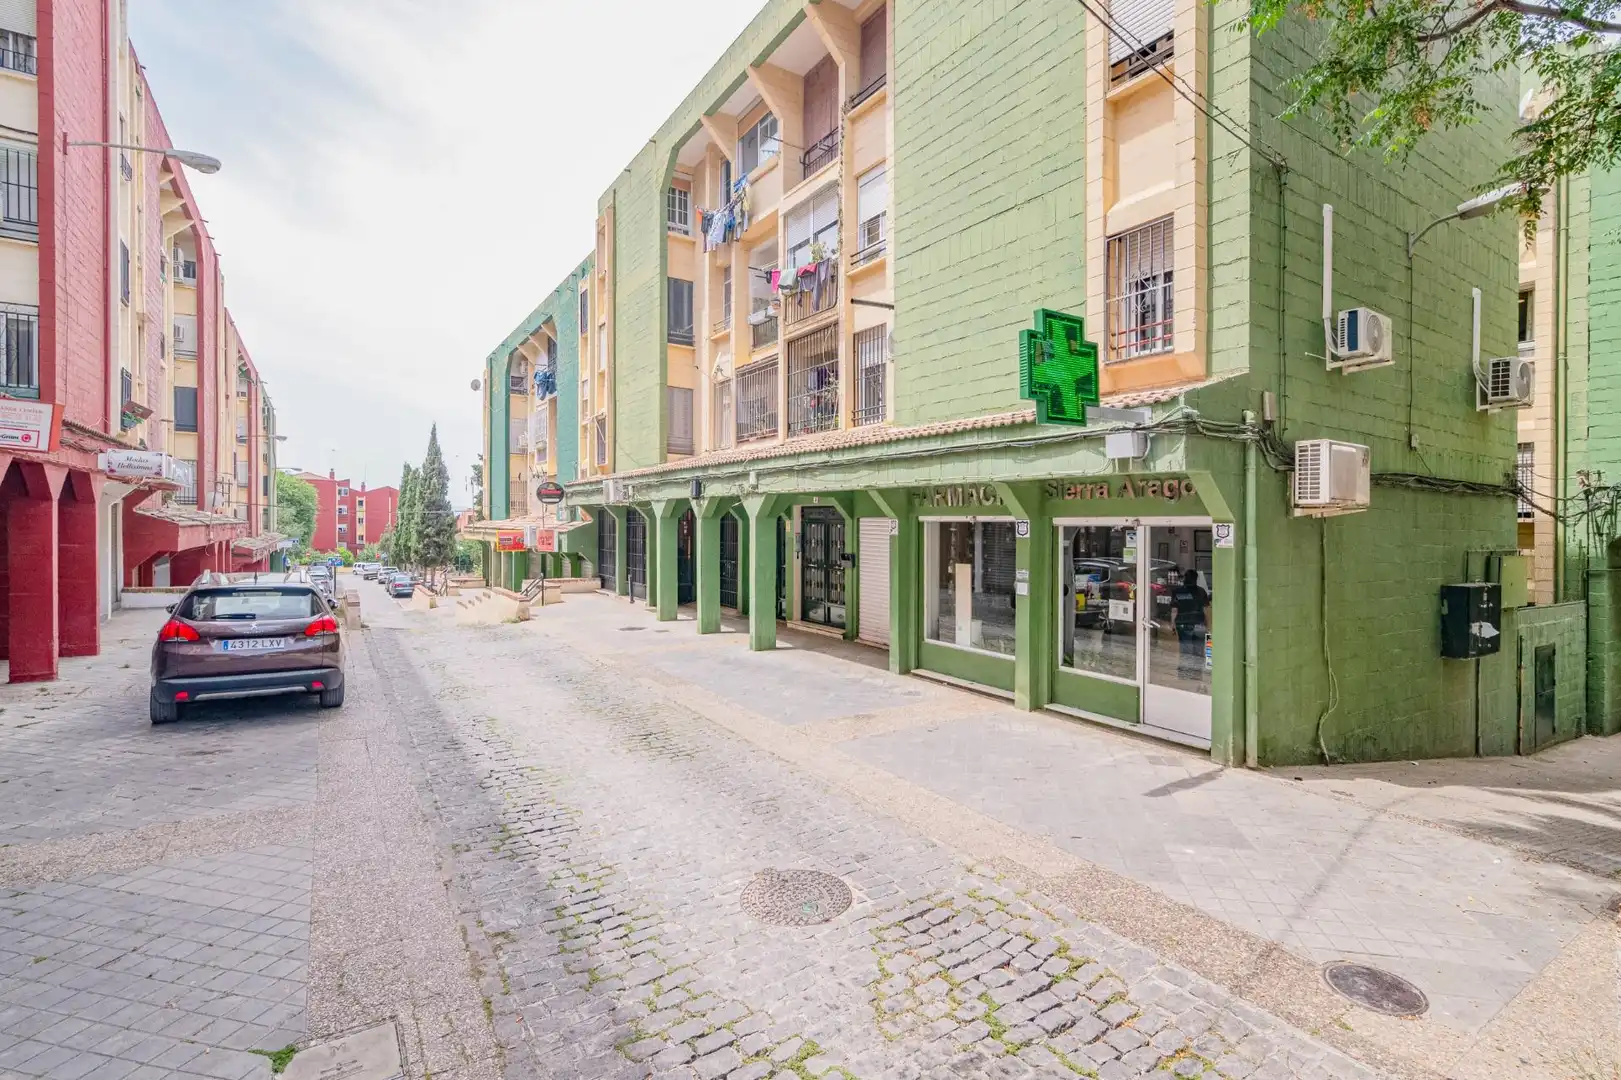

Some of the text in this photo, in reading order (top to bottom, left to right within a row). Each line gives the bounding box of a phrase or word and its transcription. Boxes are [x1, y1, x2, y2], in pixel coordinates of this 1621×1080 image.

[1045, 478, 1110, 500] Sierra
[230, 639, 282, 649] 4312 LXV
